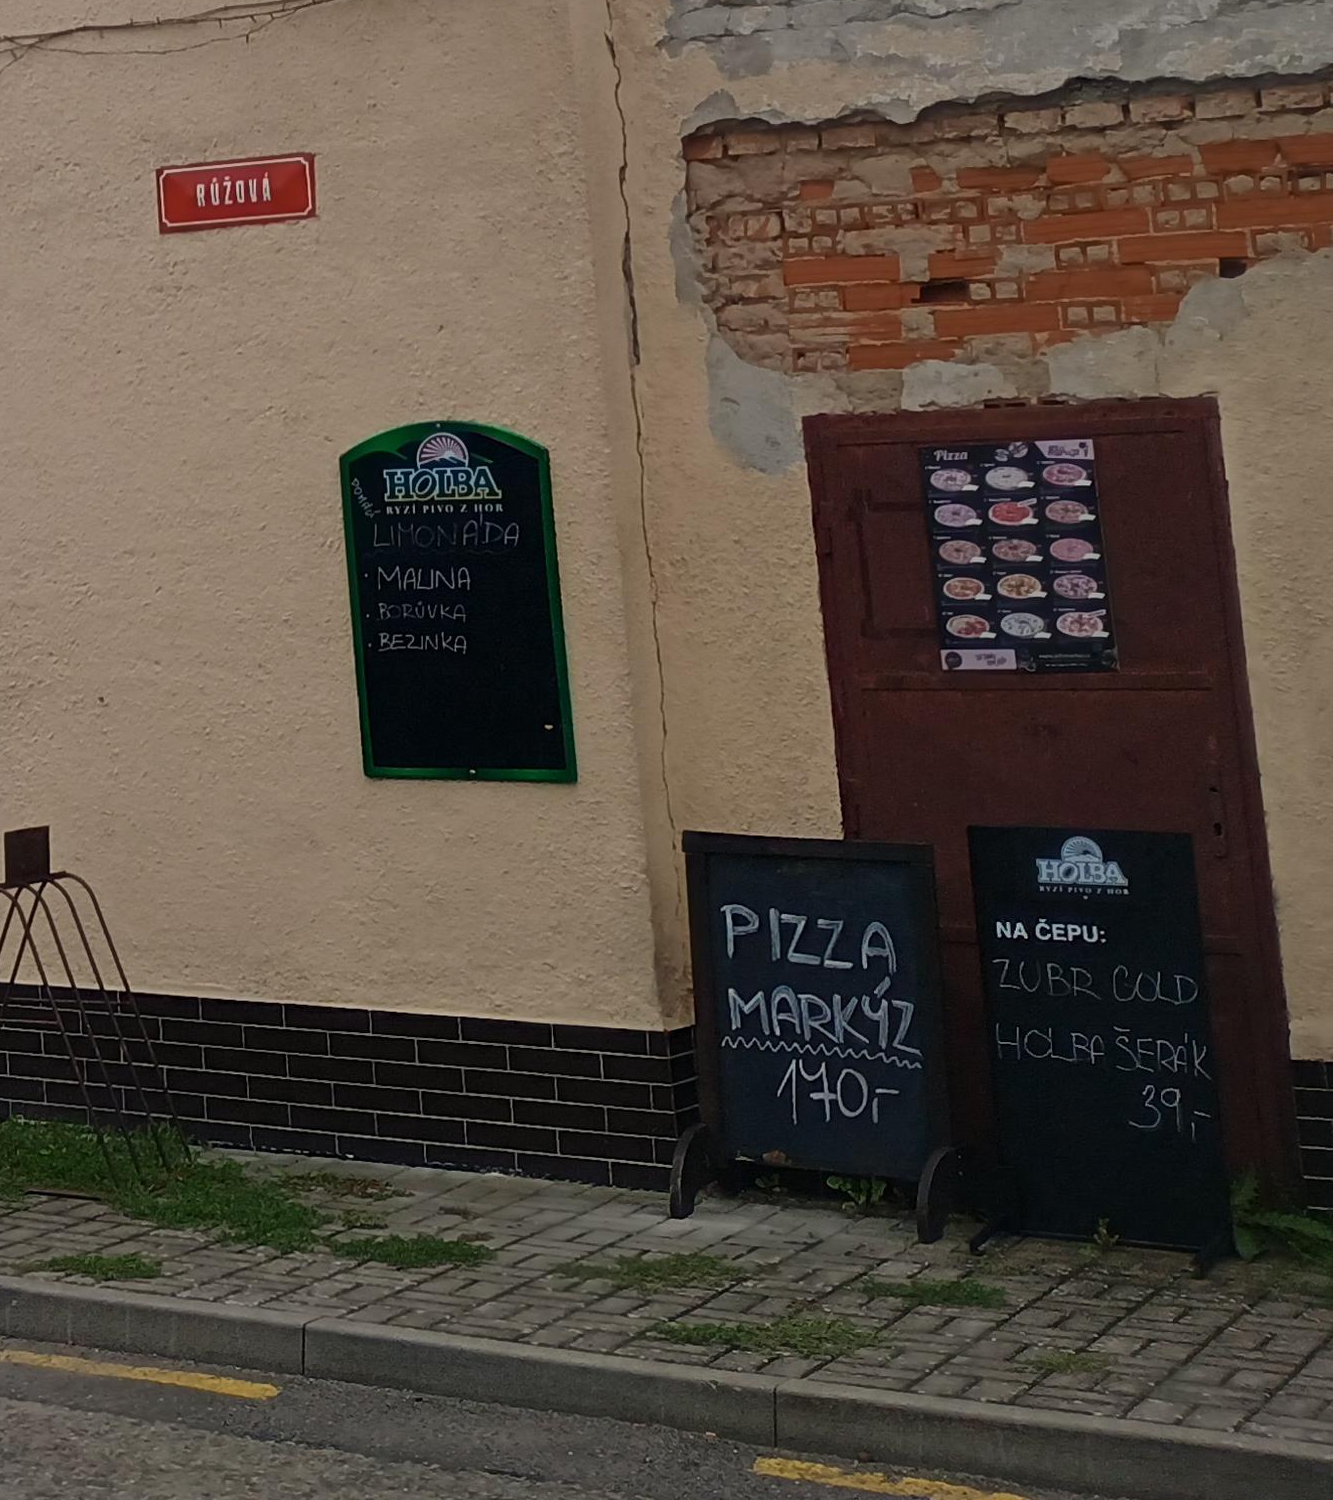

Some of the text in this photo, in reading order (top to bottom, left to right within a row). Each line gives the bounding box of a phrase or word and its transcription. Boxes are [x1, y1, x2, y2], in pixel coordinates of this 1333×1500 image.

[934, 449, 968, 461] Pizza
[384, 466, 502, 501] HOLBA
[386, 503, 504, 515] RYZÍ PIVO Z HOR
[373, 512, 519, 548] LIMONÁDA
[378, 631, 467, 655] BEZINKA
[1036, 858, 1129, 887] HOLBA
[1068, 886, 1092, 894] PIVO
[720, 903, 898, 975] PIZZA
[996, 918, 1107, 943] NA ČEPU:
[992, 959, 1100, 999] ZUBR
[727, 976, 923, 1057] MARKÝZ
[996, 1023, 1105, 1066] HOLBA
